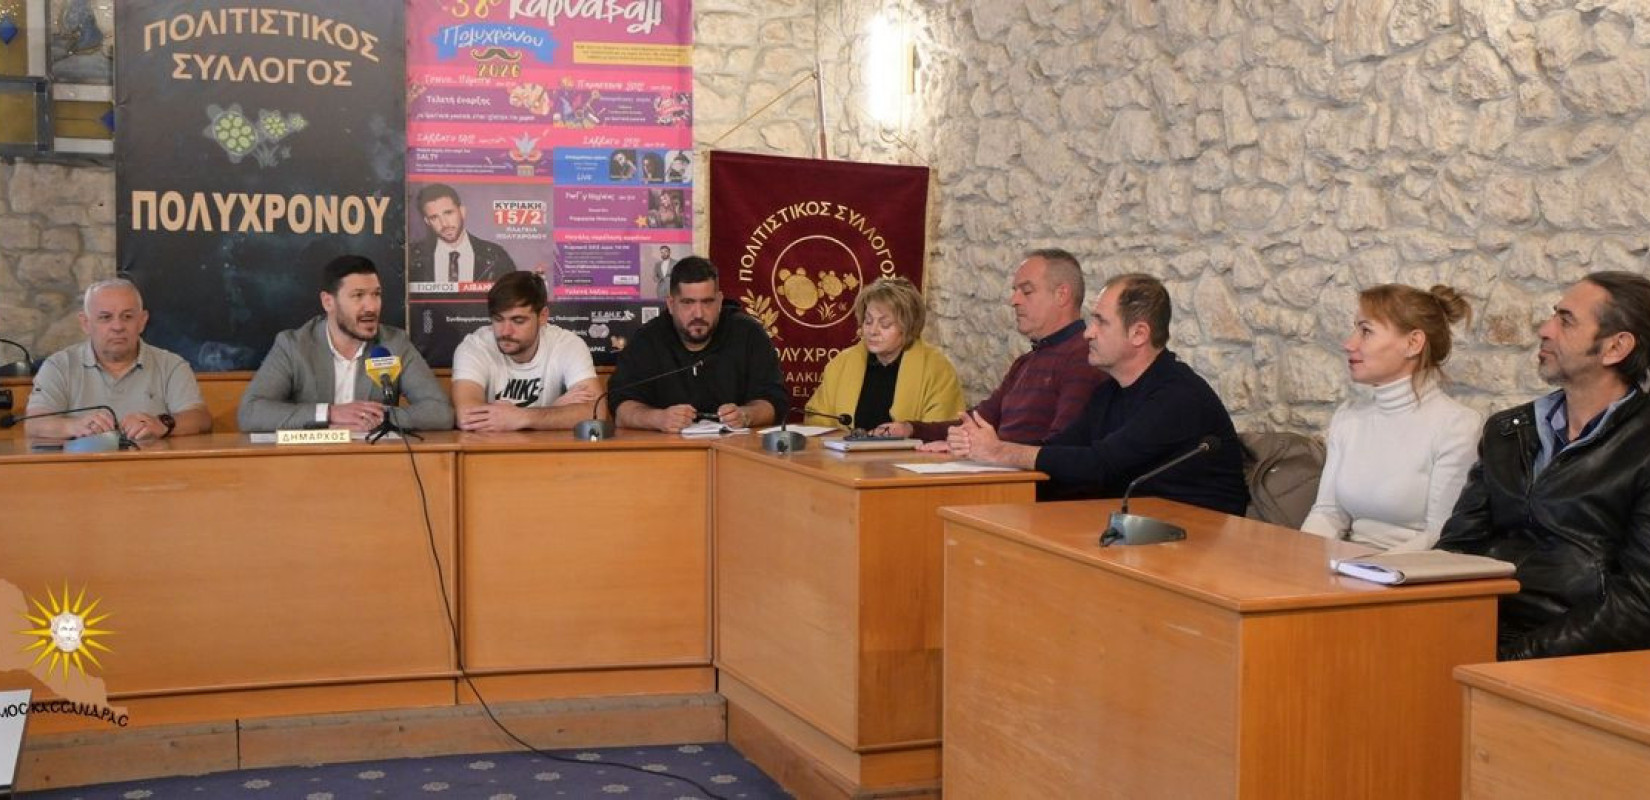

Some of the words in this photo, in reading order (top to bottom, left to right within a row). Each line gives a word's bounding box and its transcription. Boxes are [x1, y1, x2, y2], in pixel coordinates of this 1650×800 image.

[144, 8, 380, 62] ΠΟΛΙΤΙΣΤΙΚΟΣ
[172, 53, 352, 86] ΣΥΛΛΟΓΟΣ
[131, 190, 391, 235] ΠΟΛΥΧΡΟΝΟΥ
[494, 210, 542, 225] 15/2
[739, 201, 832, 281] ΠΟΛΙΤΙΣΤΙΚΟΣ
[503, 377, 542, 400] NIKE
[282, 432, 347, 441] ΔΗΜΑΡΧΟΣ
